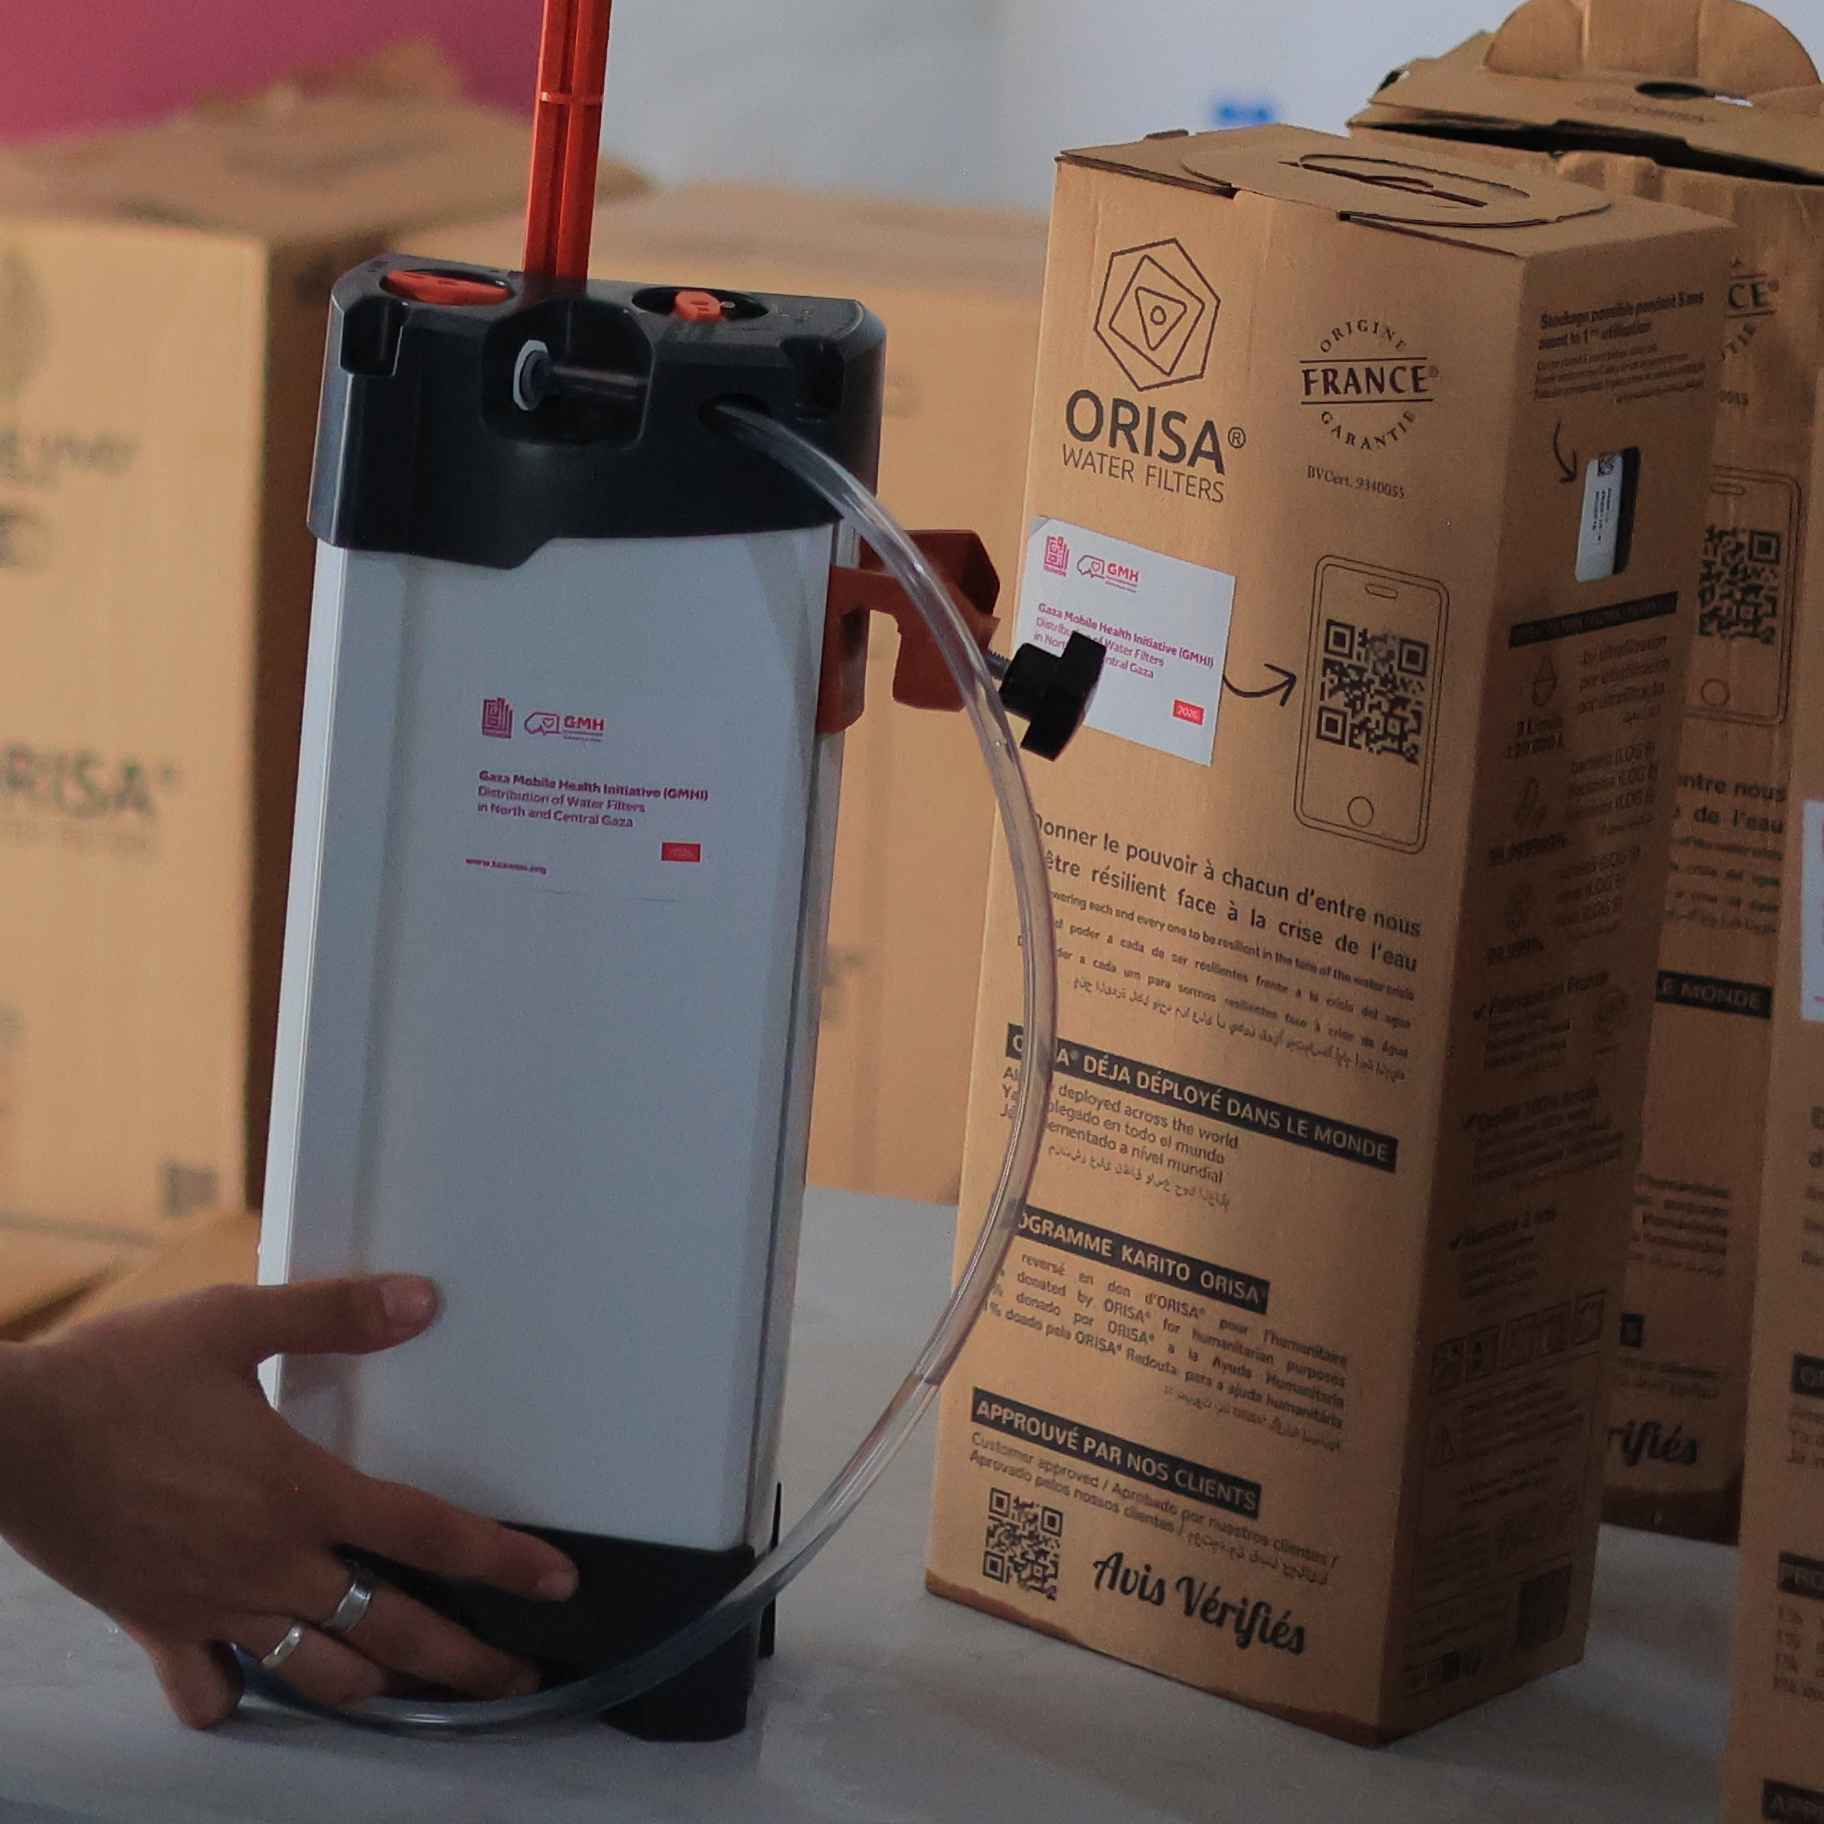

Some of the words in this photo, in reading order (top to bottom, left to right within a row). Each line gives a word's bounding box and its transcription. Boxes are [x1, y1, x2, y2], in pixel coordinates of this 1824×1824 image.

[1321, 319, 1406, 353] ORIGINE
[1322, 410, 1415, 451] GARANTIE
[1063, 444, 1134, 483] WATER
[1145, 464, 1225, 504] FILTERS
[1107, 563, 1140, 583] GMH
[1038, 603, 1062, 619] Gaza
[1065, 611, 1097, 630] Mobile
[1099, 622, 1131, 641] Health
[1134, 631, 1177, 656] Initiative
[1104, 637, 1133, 656] Water
[1135, 649, 1164, 667] Filters
[1034, 633, 1043, 641] in
[1130, 663, 1154, 679] Gaza
[564, 715, 604, 731] GMH
[478, 786, 549, 804] Distribution
[552, 795, 563, 806] of
[568, 796, 603, 809] Water
[608, 800, 645, 813] Filters
[479, 770, 509, 784] Gaza
[513, 774, 556, 789] Mobile
[559, 779, 600, 794] Health
[603, 784, 660, 798] Initiative
[478, 803, 487, 812] in
[491, 804, 525, 817] North
[528, 809, 551, 820] and
[554, 811, 599, 825] Central
[602, 815, 633, 827] Gaza
[1046, 849, 1080, 877] être
[1092, 865, 1166, 902] résilient
[1178, 889, 1216, 915] face
[1228, 900, 1238, 921] à
[1251, 909, 1266, 929] la
[1279, 920, 1323, 945] crise
[1335, 934, 1359, 955] de
[1104, 833, 1120, 854] le
[1127, 843, 1198, 875] pouvoir
[1204, 859, 1215, 880] à
[1223, 868, 1289, 901] chacun
[1374, 912, 1421, 938] nous
[1115, 908, 1134, 921] and
[1138, 915, 1164, 932] every
[1189, 928, 1200, 940] to
[1058, 1084, 1122, 1114] deployed
[1124, 1105, 1169, 1128] across
[1172, 1117, 1195, 1136] the
[1199, 1126, 1239, 1149] world
[1083, 1054, 1131, 1085] DÉJA
[1136, 1069, 1222, 1111] DÉPLOYÉ
[1227, 1099, 1282, 1129] DANS
[1286, 1116, 1308, 1138] LE
[1314, 1125, 1388, 1161] MONDE
[1104, 1118, 1121, 1134] en
[1125, 1121, 1157, 1142] todo
[1160, 1132, 1173, 1146] el
[1176, 1139, 1225, 1165] mundo
[1132, 1143, 1163, 1166] nível
[1167, 1156, 1223, 1184] mundial
[1022, 1253, 1065, 1276] reversé
[1108, 1280, 1130, 1297] don
[1121, 1244, 1190, 1282] KARITO
[1016, 1292, 1061, 1316] donado
[1018, 1271, 1066, 1297] donated
[1077, 1291, 1094, 1308] by
[1163, 1317, 1181, 1334] for
[976, 1400, 1080, 1450] APPROUVÉ
[1083, 1437, 1121, 1465] PAR
[1127, 1453, 1168, 1481] NOS
[1175, 1469, 1256, 1510] CLIENTS
[1609, 1419, 1699, 1467] rifiés
[970, 1449, 1031, 1482] Aprovado
[1035, 1475, 1070, 1495] pelos
[972, 1431, 1034, 1464] Customer
[1037, 1457, 1098, 1488] approved
[1111, 1481, 1177, 1515] Aprobado
[1093, 1551, 1166, 1606] Avis
[1175, 1576, 1305, 1655] Vérifiés
